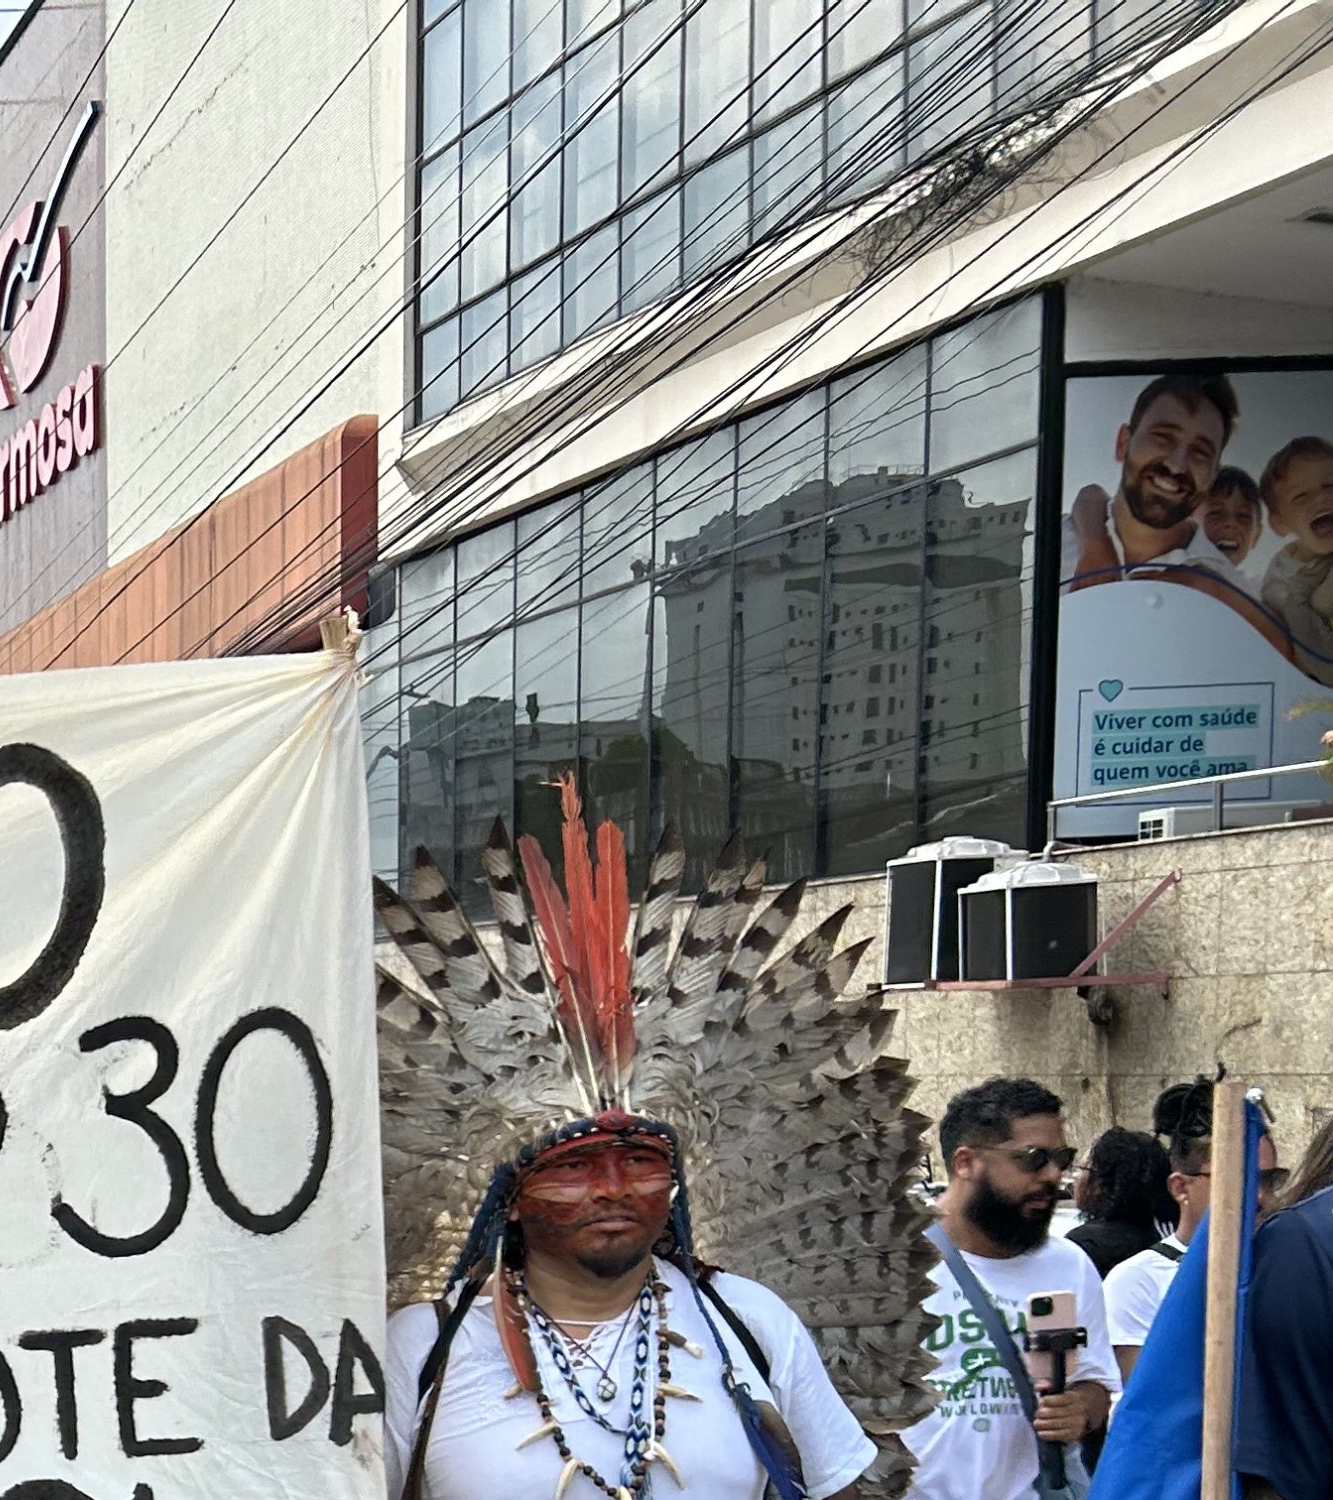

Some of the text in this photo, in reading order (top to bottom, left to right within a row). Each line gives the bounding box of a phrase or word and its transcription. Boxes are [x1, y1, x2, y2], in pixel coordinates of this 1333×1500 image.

[1095, 708, 1258, 731] Viver com saúde
[1094, 736, 1205, 756] é cuidar de
[1093, 766, 1149, 785] quem
[1156, 760, 1201, 778] você
[51, 1007, 334, 1258] 30
[261, 1315, 386, 1447] DA
